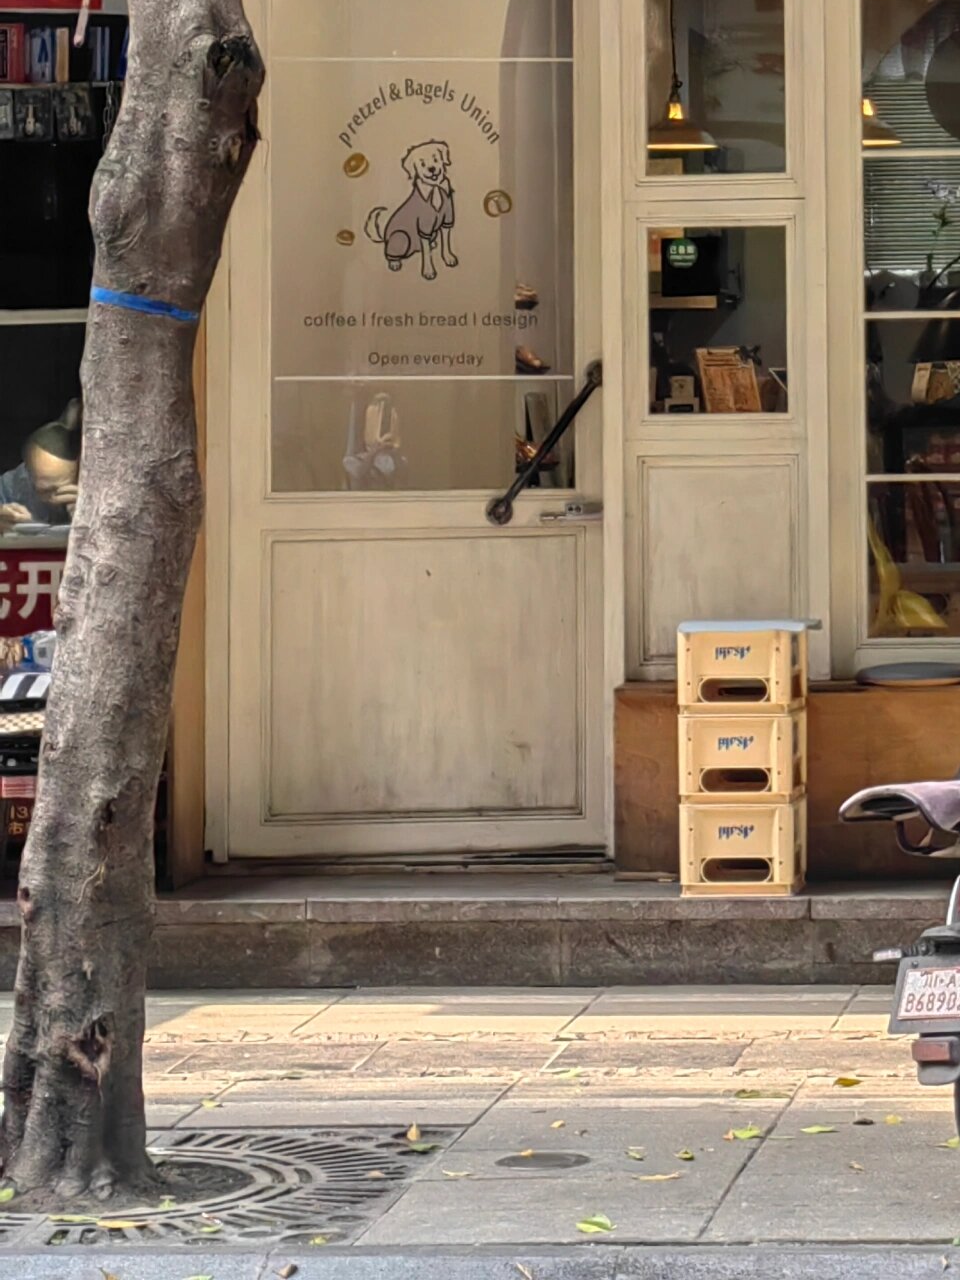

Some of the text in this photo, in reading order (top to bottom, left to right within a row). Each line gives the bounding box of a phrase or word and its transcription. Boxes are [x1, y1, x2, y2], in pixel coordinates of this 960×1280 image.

[404, 78, 455, 105] Bagels
[460, 93, 500, 145] Union
[303, 312, 357, 327] coffee
[371, 312, 414, 327] fresh
[419, 312, 468, 327] bread
[481, 312, 539, 329] design
[368, 351, 484, 368] Open everyday
